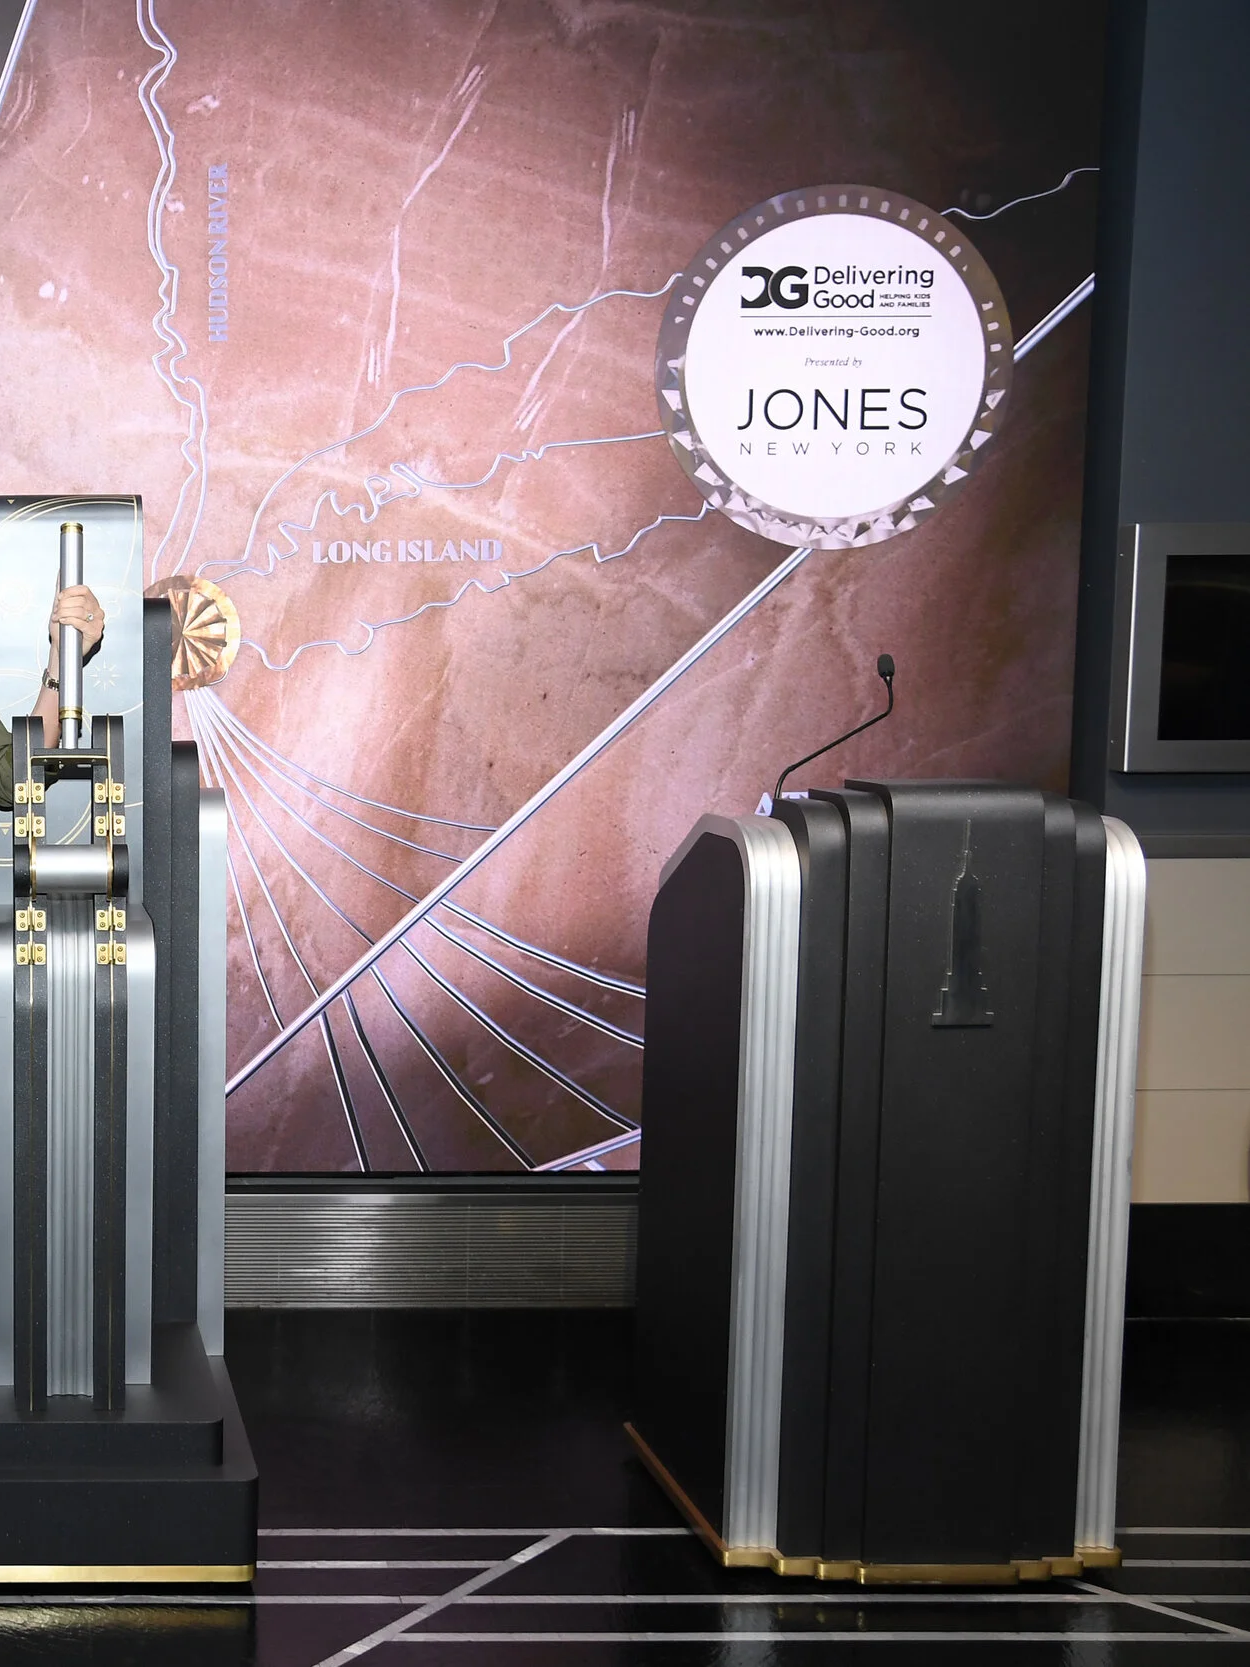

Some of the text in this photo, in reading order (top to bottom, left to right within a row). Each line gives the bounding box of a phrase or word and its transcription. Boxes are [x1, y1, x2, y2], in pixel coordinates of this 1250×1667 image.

[208, 162, 229, 342] HUDSON RIVER
[814, 265, 935, 289] Delivering
[813, 289, 875, 308] Good
[753, 326, 920, 338] www.Delivering-Good.org
[804, 357, 862, 368] Presented by
[737, 388, 928, 430] JONES
[740, 442, 922, 455] NEW YORK
[312, 539, 503, 563] LONG ISLAND
